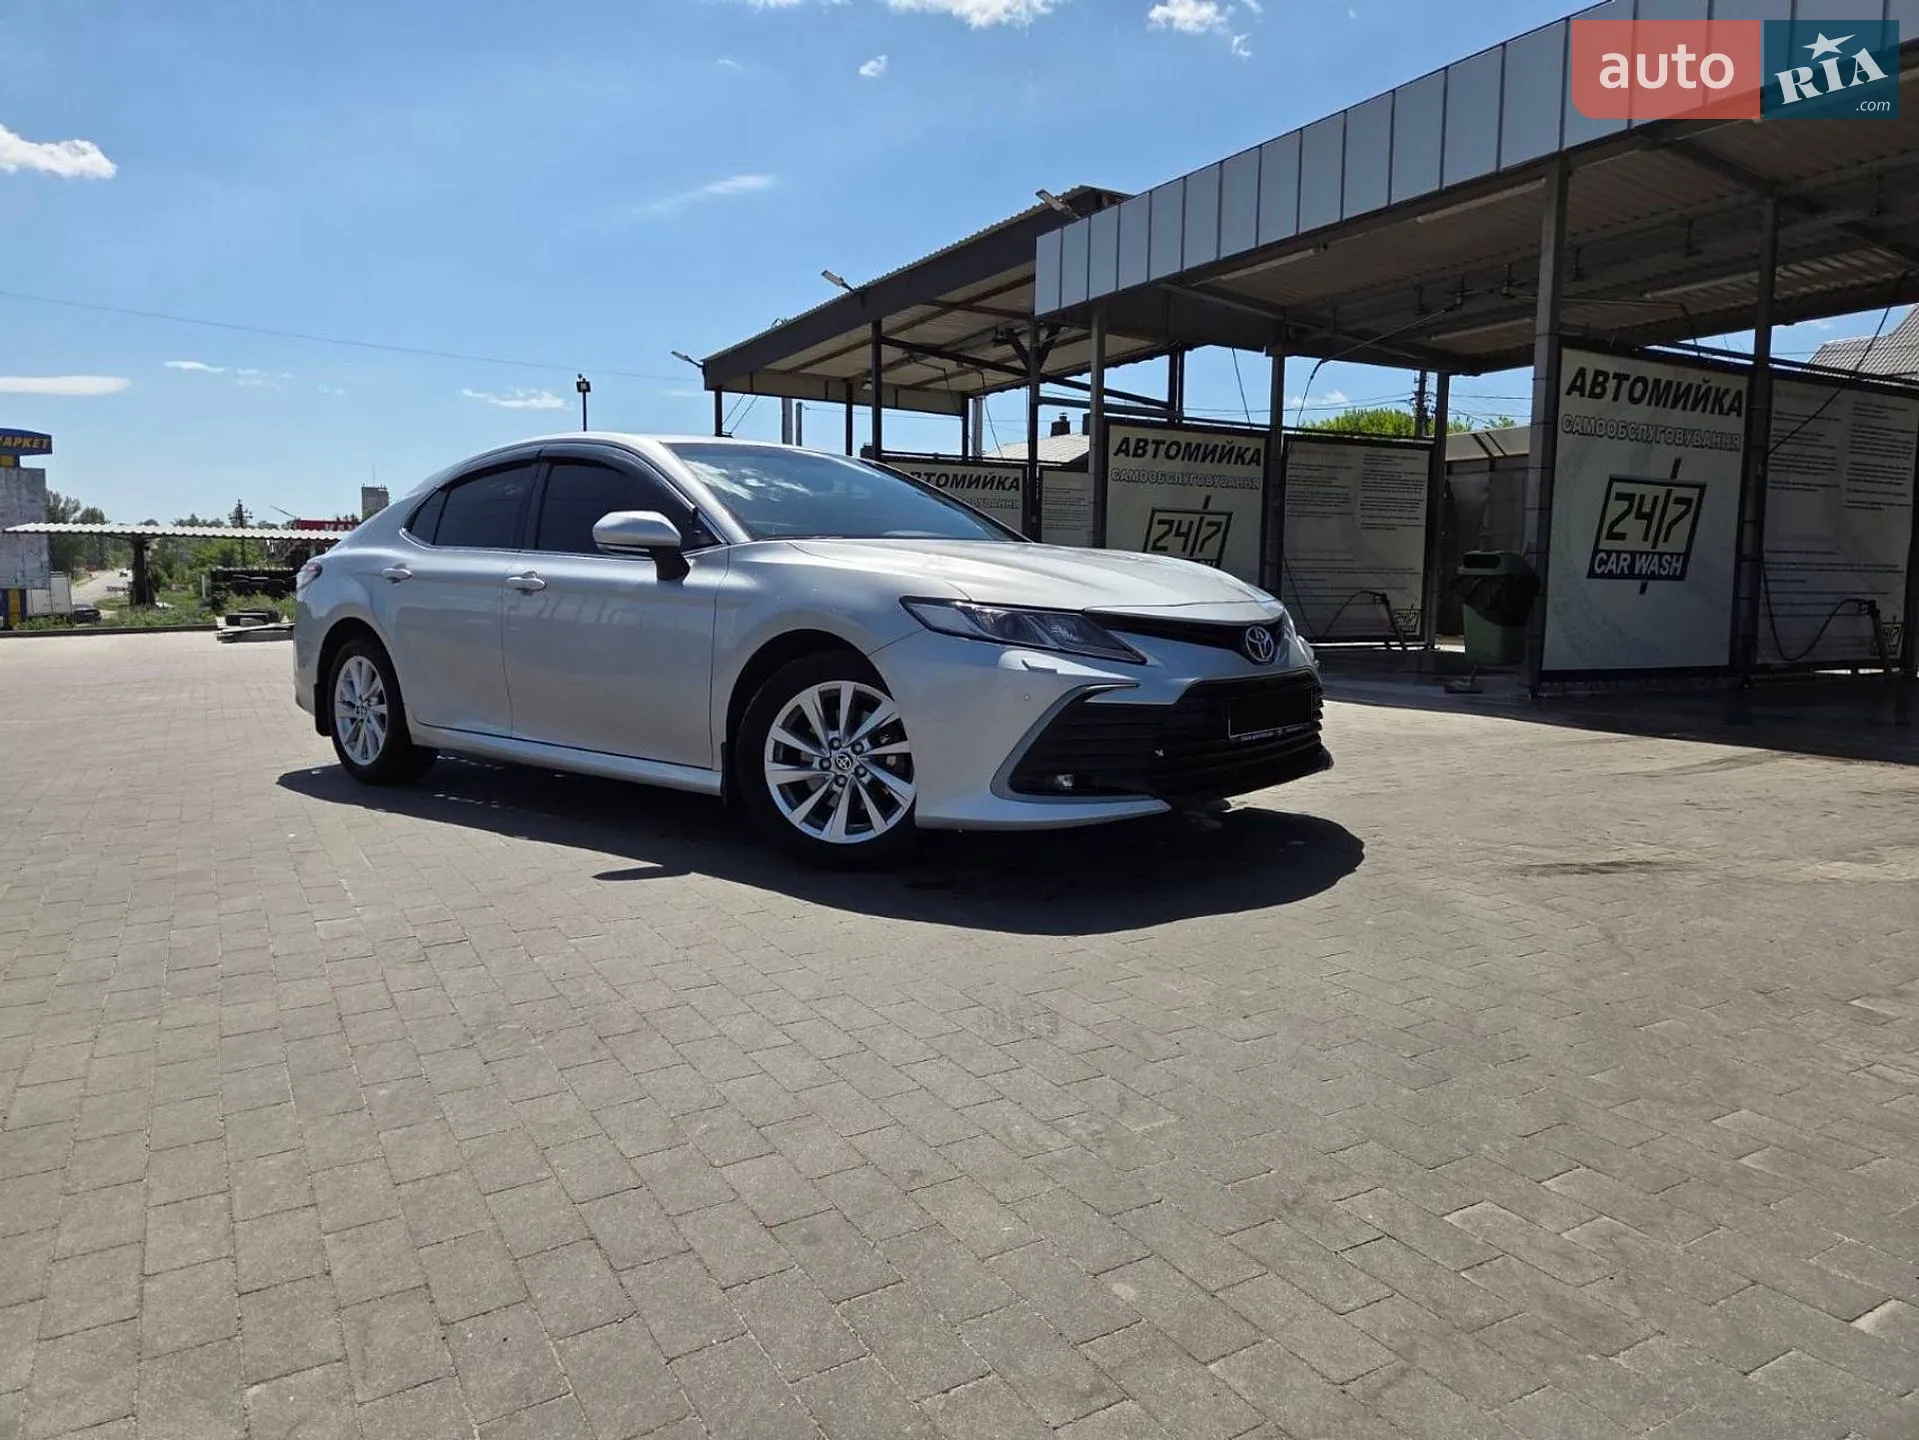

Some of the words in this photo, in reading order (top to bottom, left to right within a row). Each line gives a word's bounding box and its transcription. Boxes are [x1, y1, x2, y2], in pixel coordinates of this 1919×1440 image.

[1565, 366, 1743, 418] АВТОМИЙКА
[1113, 436, 1262, 467] АВТОМИЙКА
[1561, 413, 1742, 452] САМООБСЛУГОВУВАННЯ
[1151, 516, 1223, 557] 24/7
[1606, 488, 1694, 550] 24/7
[1593, 551, 1630, 575] CAR
[1634, 553, 1684, 577] WASH
